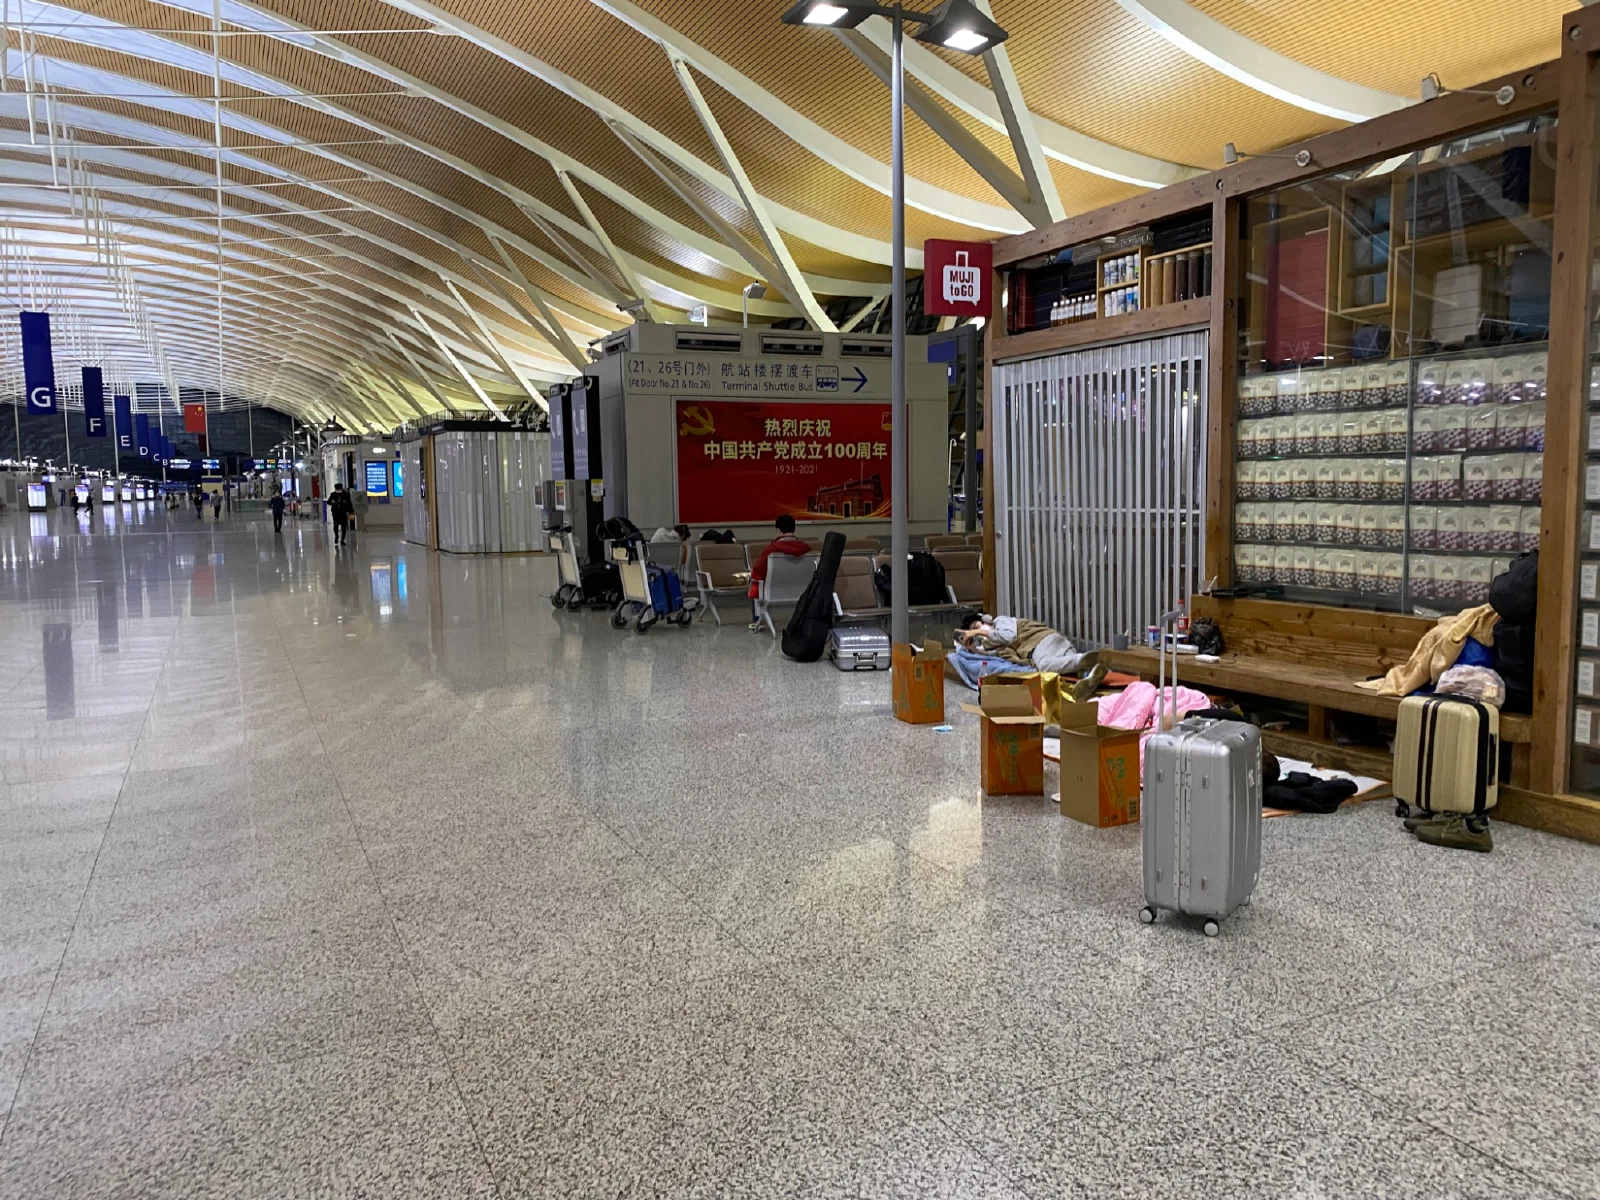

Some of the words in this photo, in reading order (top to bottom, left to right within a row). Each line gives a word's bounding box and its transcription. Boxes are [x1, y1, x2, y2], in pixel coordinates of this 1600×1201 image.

[949, 270, 974, 284] MUJI
[721, 362, 814, 379] 航站楼摆渡车
[640, 379, 657, 388] Door
[681, 381, 687, 389] &
[721, 381, 761, 391] Terminal
[763, 382, 796, 392] Shuttle
[798, 383, 813, 391] Bus
[30, 387, 51, 408] G
[90, 418, 101, 432] F
[511, 411, 550, 432] 上海
[764, 418, 832, 437] 热烈庆祝
[120, 435, 131, 447] E
[139, 446, 149, 456] D
[703, 440, 888, 460] 中国共产党成立100周年
[153, 453, 160, 462] C
[162, 458, 169, 467] B
[775, 465, 818, 475] 1921-2021
